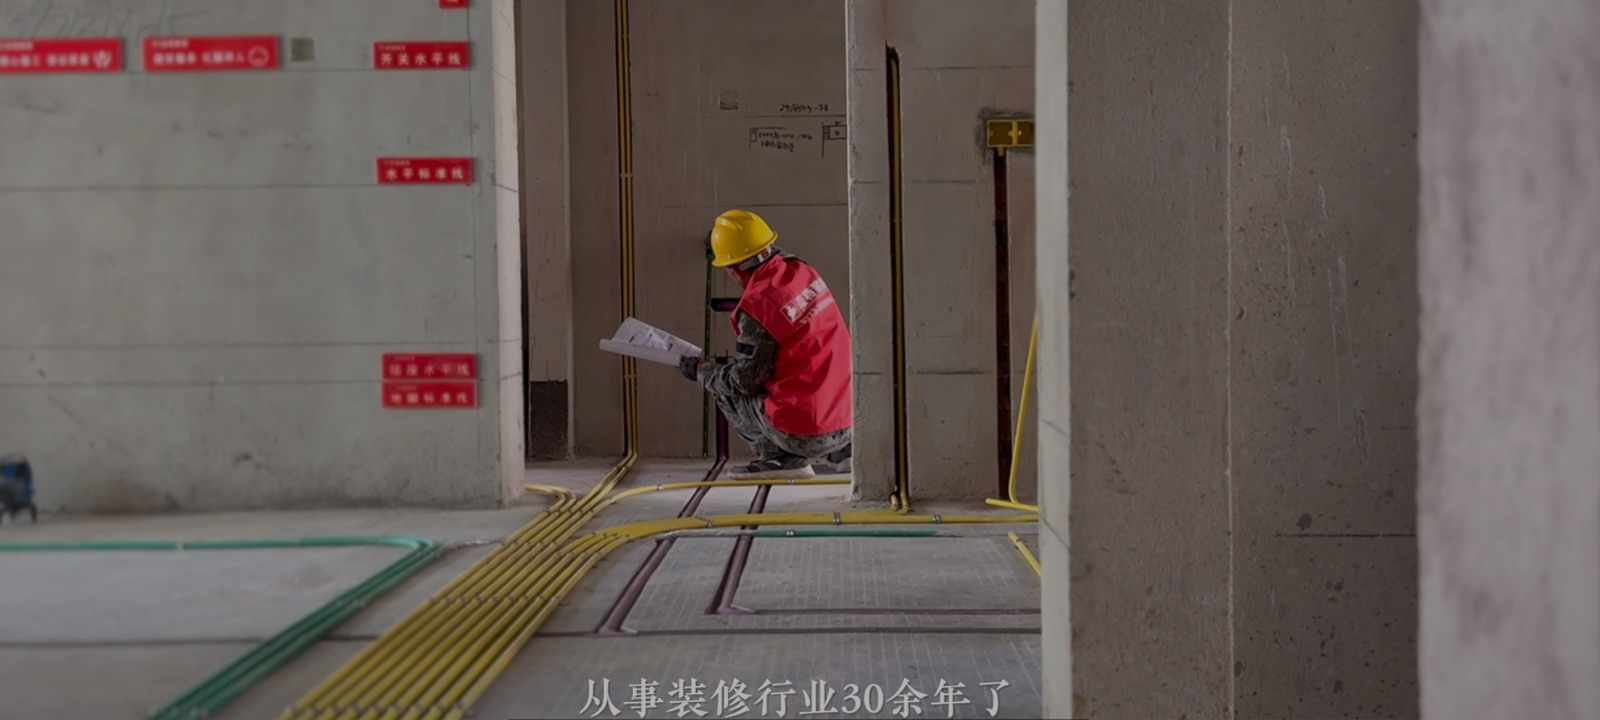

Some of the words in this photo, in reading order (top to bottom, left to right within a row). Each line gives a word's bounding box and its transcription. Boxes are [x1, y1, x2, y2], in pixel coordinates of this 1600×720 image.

[381, 52, 460, 66] 开关水平线
[386, 166, 463, 180] 水平标准线
